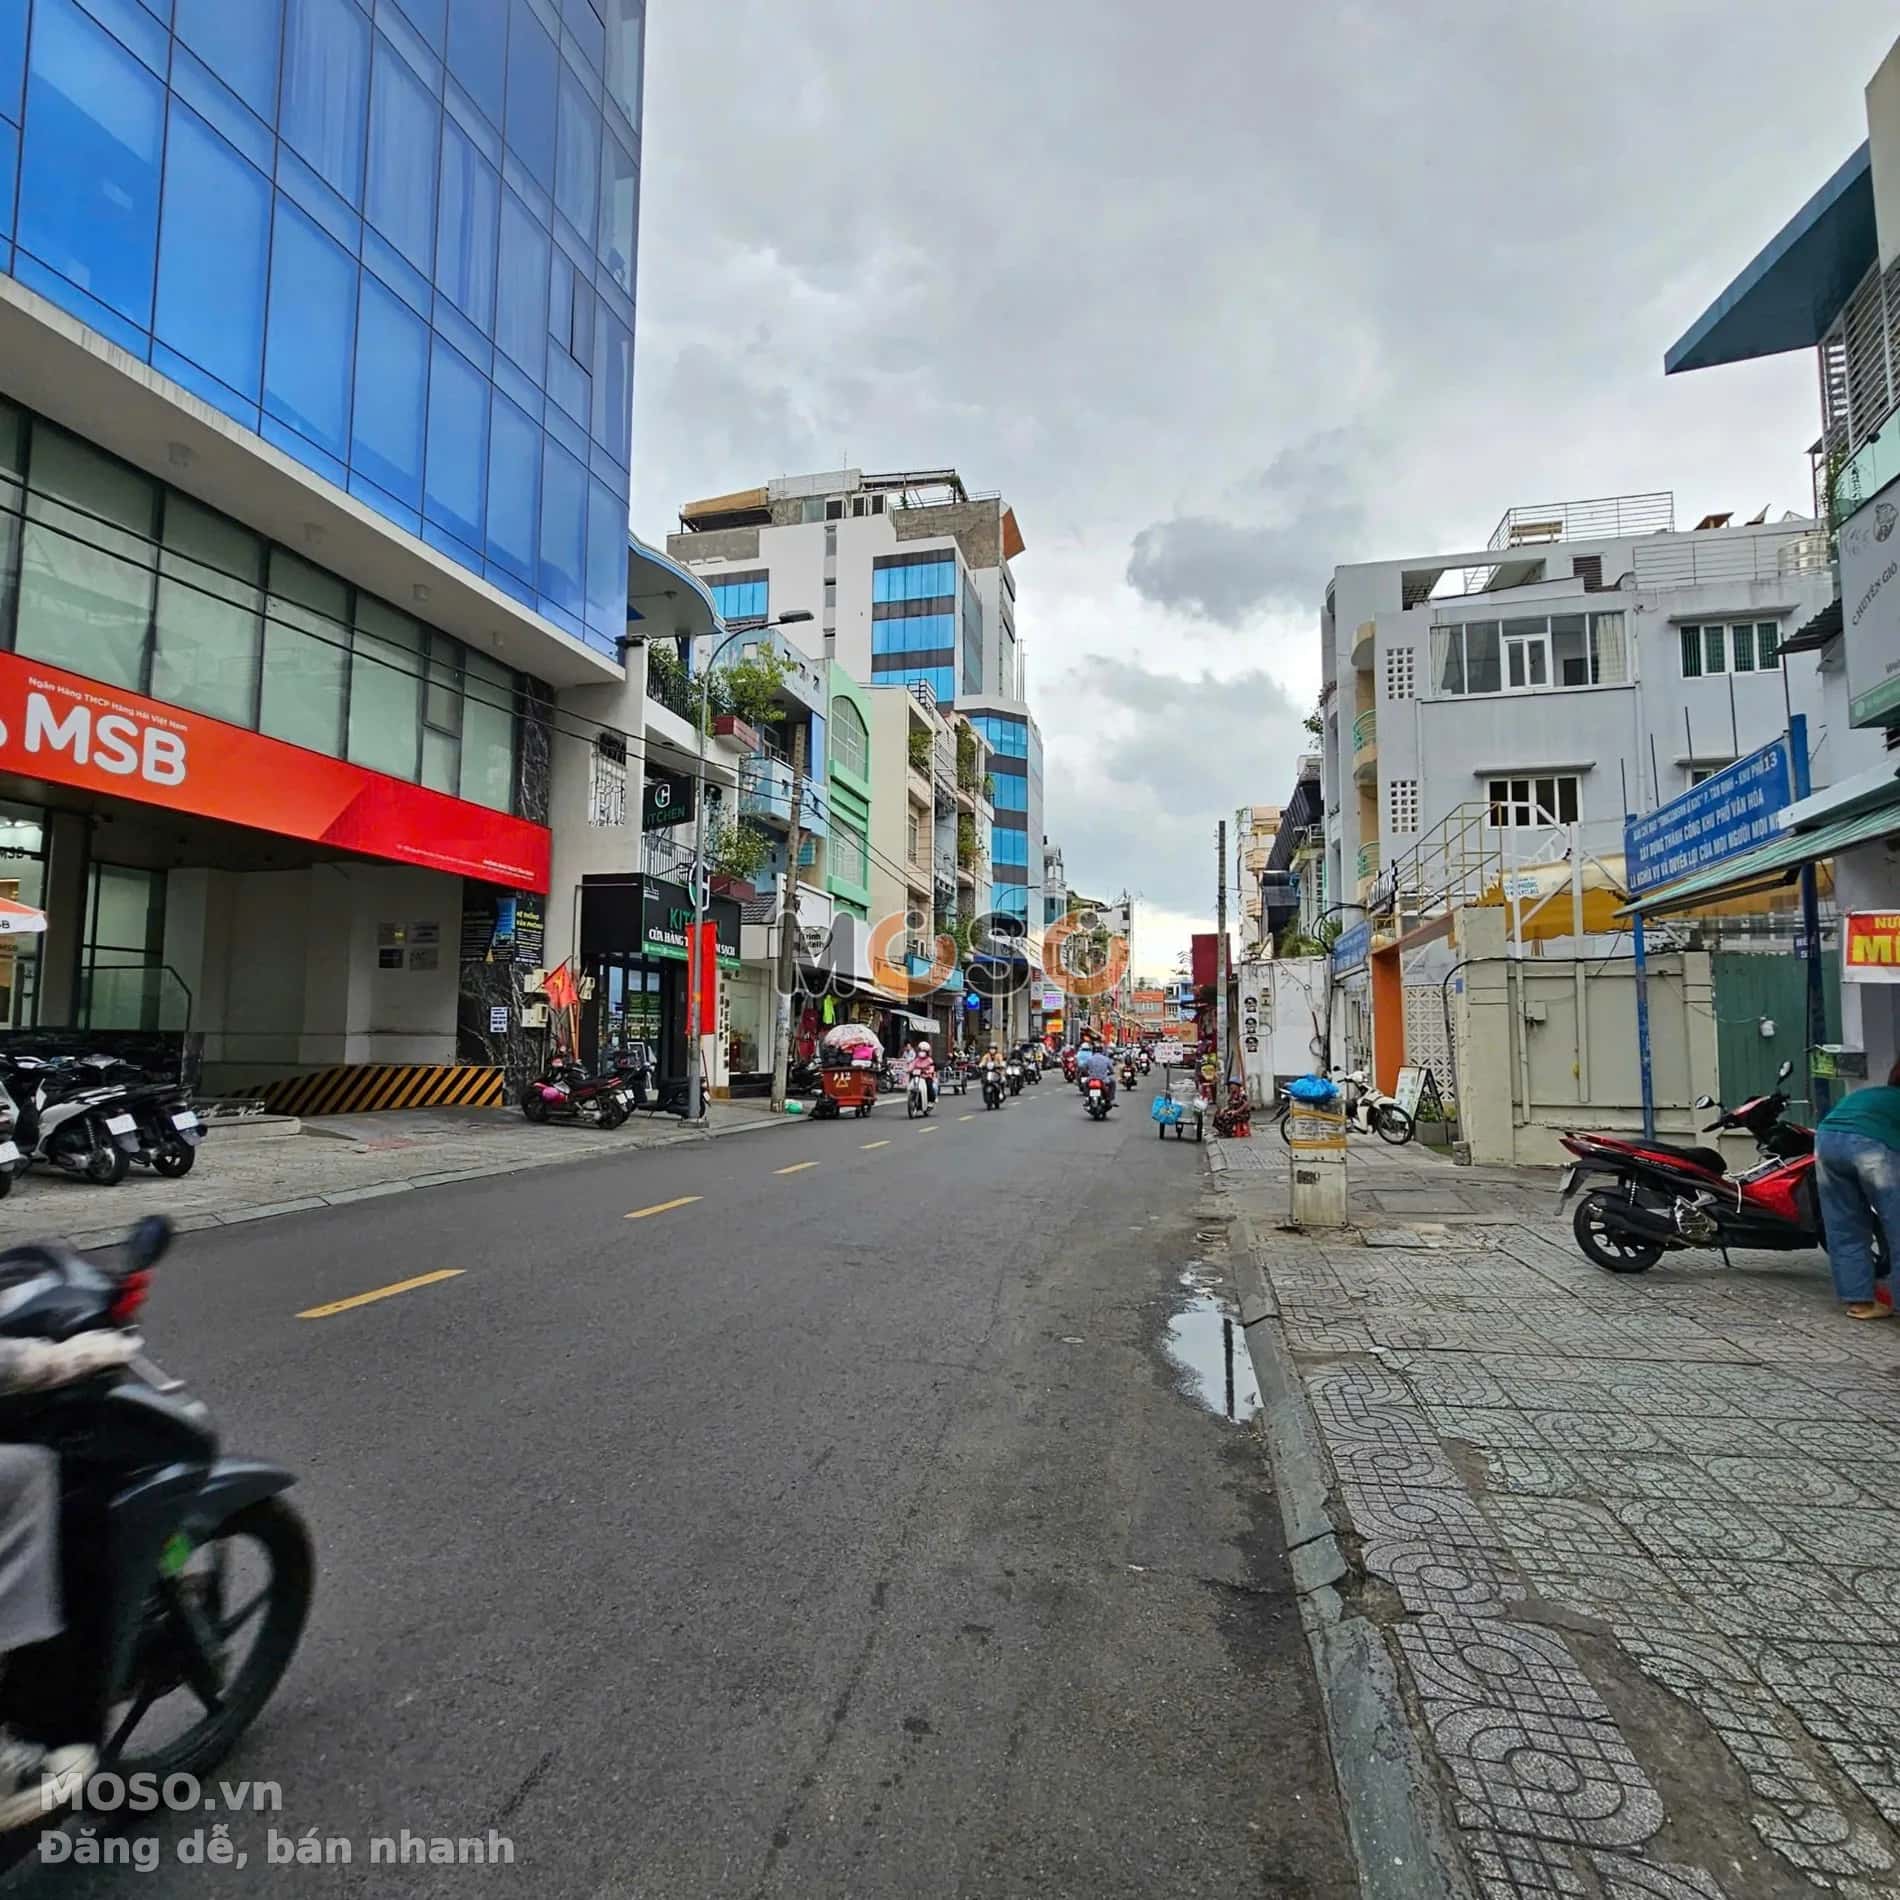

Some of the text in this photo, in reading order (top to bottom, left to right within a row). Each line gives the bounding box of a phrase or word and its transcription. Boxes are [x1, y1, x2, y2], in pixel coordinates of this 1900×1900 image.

[24, 691, 187, 786] MSB
[1763, 751, 1778, 772] 13
[643, 804, 686, 826] ITCHEN
